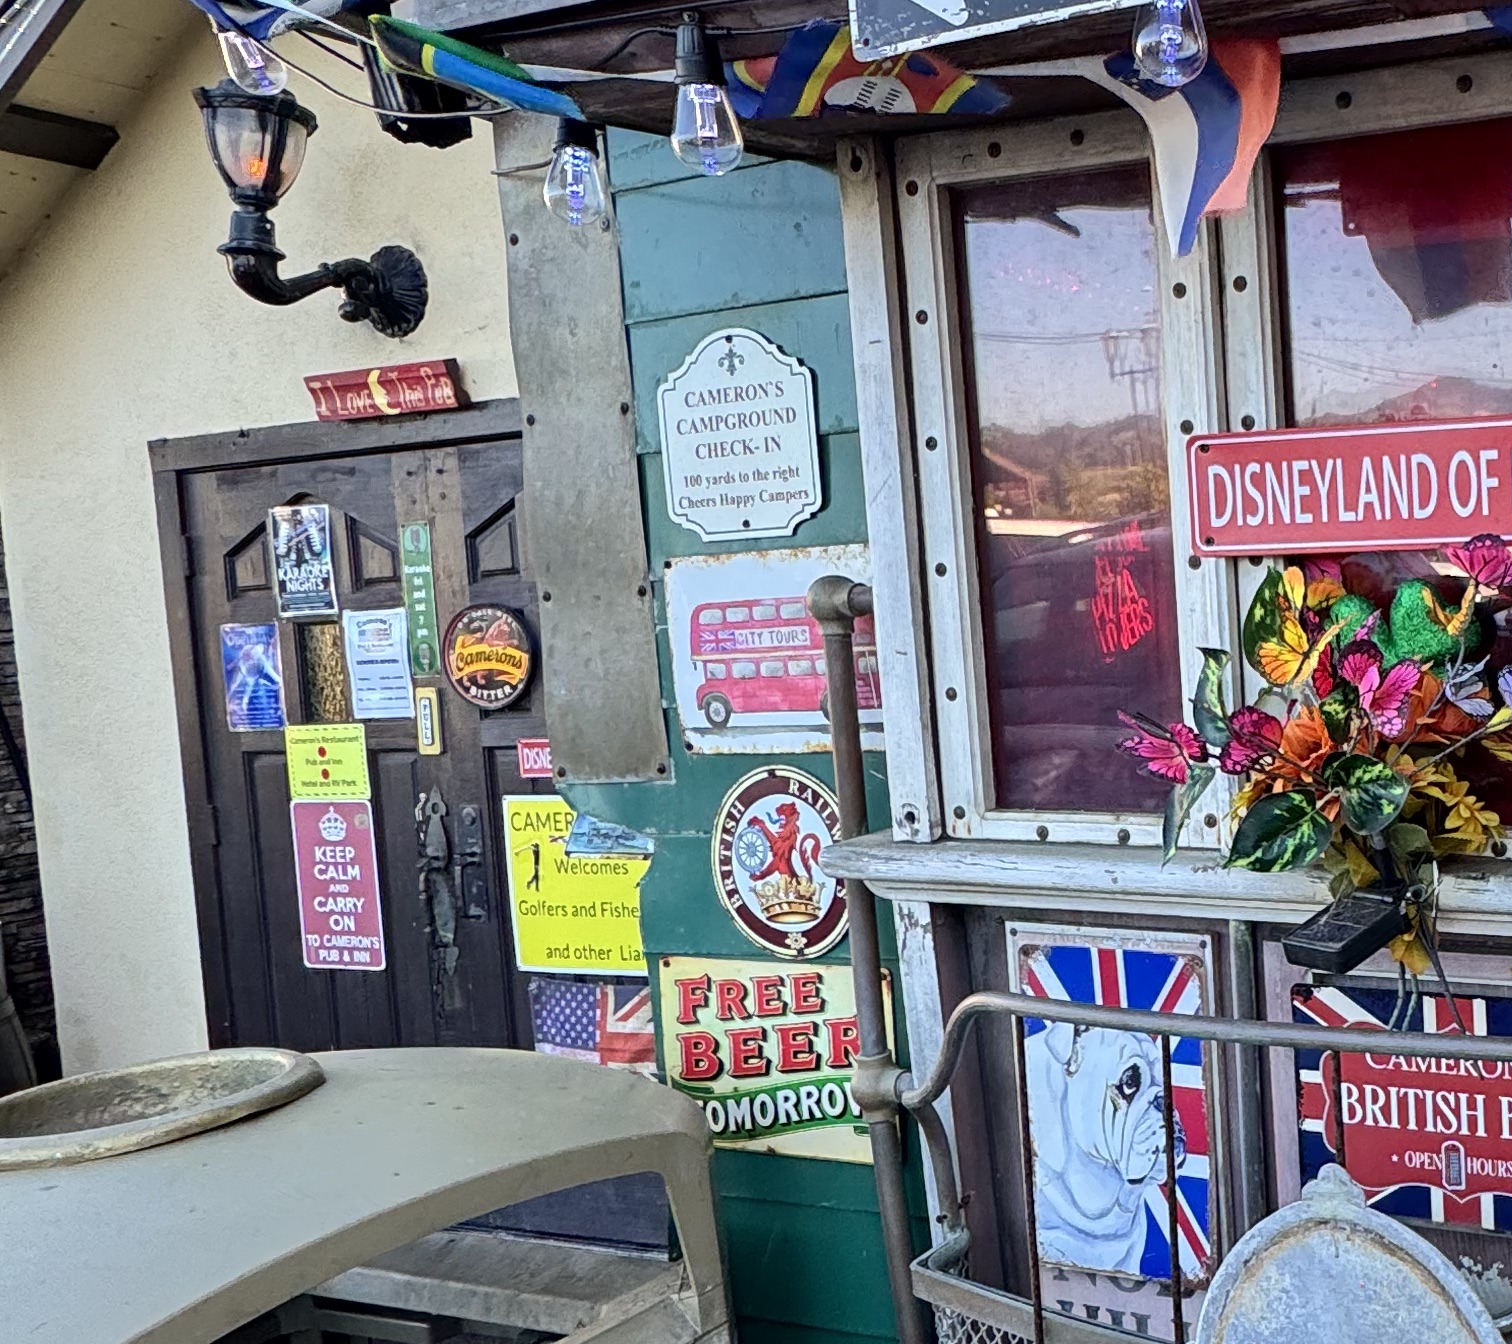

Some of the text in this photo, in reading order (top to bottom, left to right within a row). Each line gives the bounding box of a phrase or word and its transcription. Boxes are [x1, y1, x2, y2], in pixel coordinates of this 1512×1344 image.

[684, 381, 785, 409] CAMERON'S
[676, 407, 797, 436] CAMPGROUND
[764, 435, 782, 453] IN
[683, 465, 800, 487] 100 yards to the right
[1208, 453, 1437, 527] DISNEYLAND
[1447, 449, 1499, 517] OF
[679, 488, 809, 511] Cheers Happy Campers
[286, 578, 324, 593] NIGHTS
[736, 627, 808, 646] CITY TOURS
[456, 649, 522, 672] Camerons
[469, 685, 513, 700] BITTER
[314, 846, 355, 862] KEEP
[718, 800, 746, 910] BRITISH
[314, 864, 360, 880] CALM
[554, 858, 629, 875] Welcomes
[328, 884, 349, 893] AND
[313, 897, 364, 913] CARRY
[519, 900, 568, 916] Golfers
[571, 901, 597, 917] and
[328, 914, 355, 931] ON
[306, 934, 380, 949] TO CAMERON'S
[318, 948, 371, 964] PUB & INN
[546, 943, 570, 959] and
[573, 944, 612, 960] other
[675, 973, 823, 1023] FREE
[677, 1017, 860, 1080] BEER
[697, 1081, 861, 1133] OMORRO
[1341, 1083, 1487, 1137] BRITISH
[1404, 1150, 1442, 1170] OPEN
